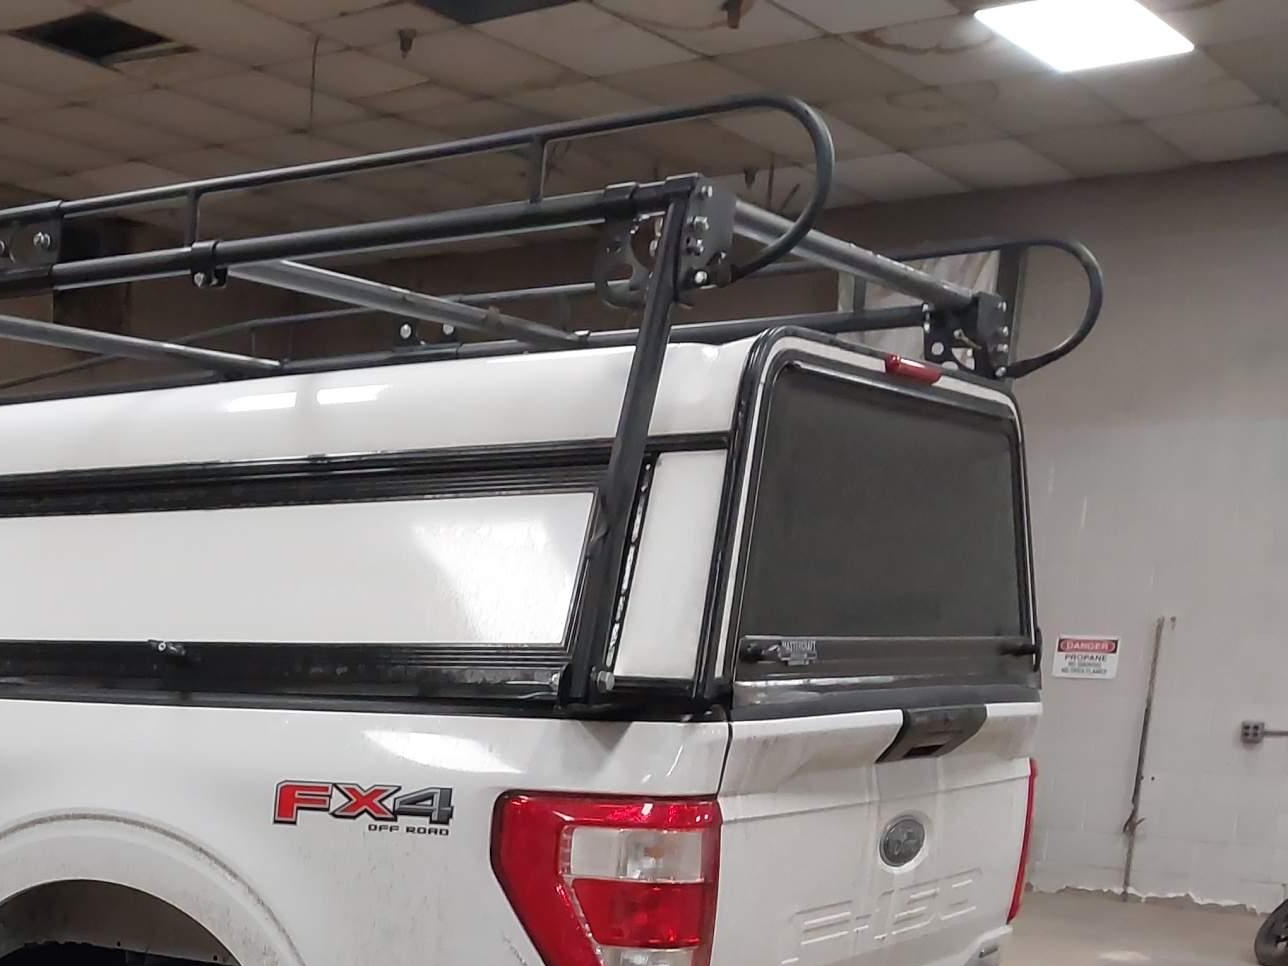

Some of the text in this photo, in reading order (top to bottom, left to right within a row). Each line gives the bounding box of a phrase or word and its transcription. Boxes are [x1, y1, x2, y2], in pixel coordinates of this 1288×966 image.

[1066, 641, 1109, 651] DANGER
[273, 780, 454, 825] FX4
[368, 823, 450, 836] OFF ROAD
